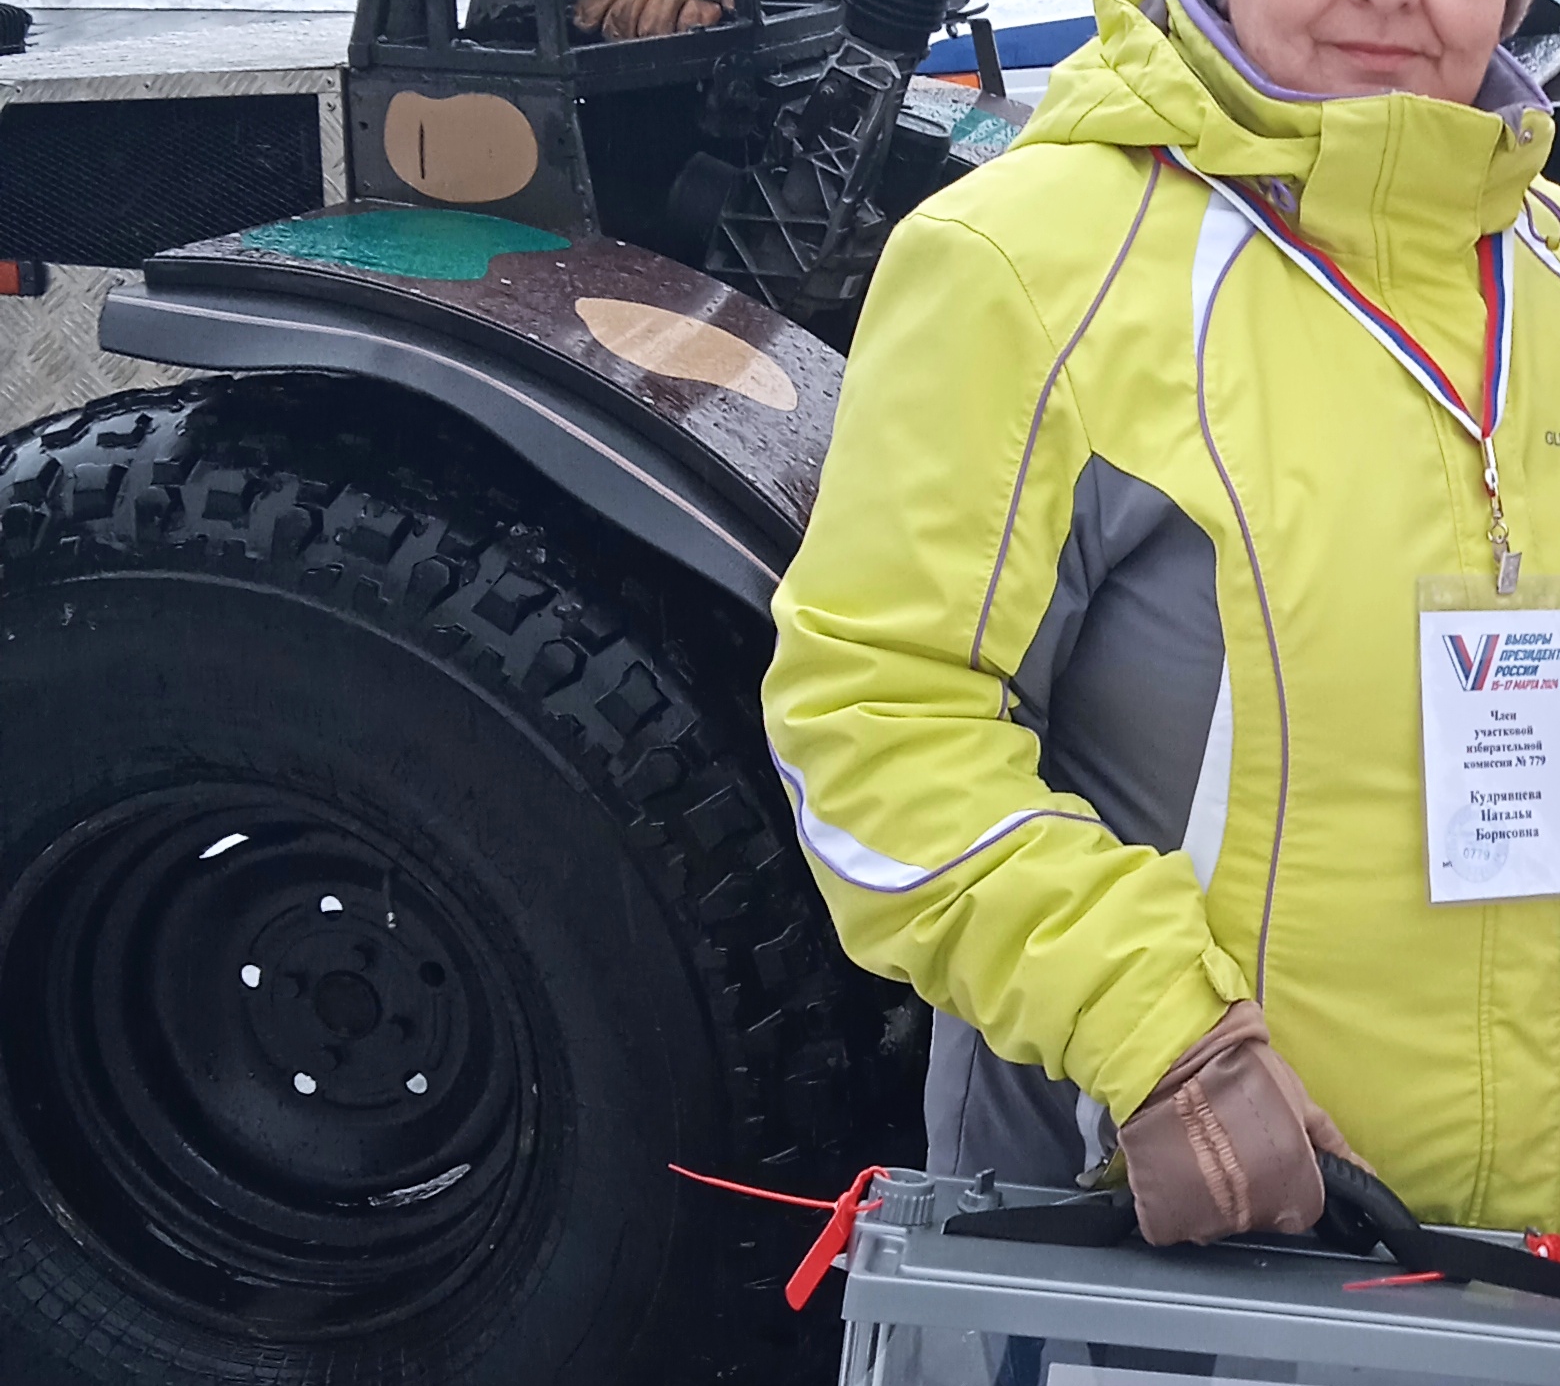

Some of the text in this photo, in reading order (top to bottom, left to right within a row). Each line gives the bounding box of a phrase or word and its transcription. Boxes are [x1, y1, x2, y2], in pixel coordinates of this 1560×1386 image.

[1505, 633, 1553, 645] ВЫБОРЫ
[1494, 665, 1539, 677] РОССИИ
[1513, 679, 1539, 691] МАРТА
[1540, 679, 1559, 690] 2024
[1491, 710, 1517, 721] Член
[1474, 726, 1534, 740] участковой
[1466, 741, 1542, 755] избирательной
[1463, 755, 1546, 769] комиссии № 779
[1470, 790, 1542, 806] Кудрявцева
[1481, 809, 1532, 822] Наталья
[1476, 827, 1540, 843] Борисовна
